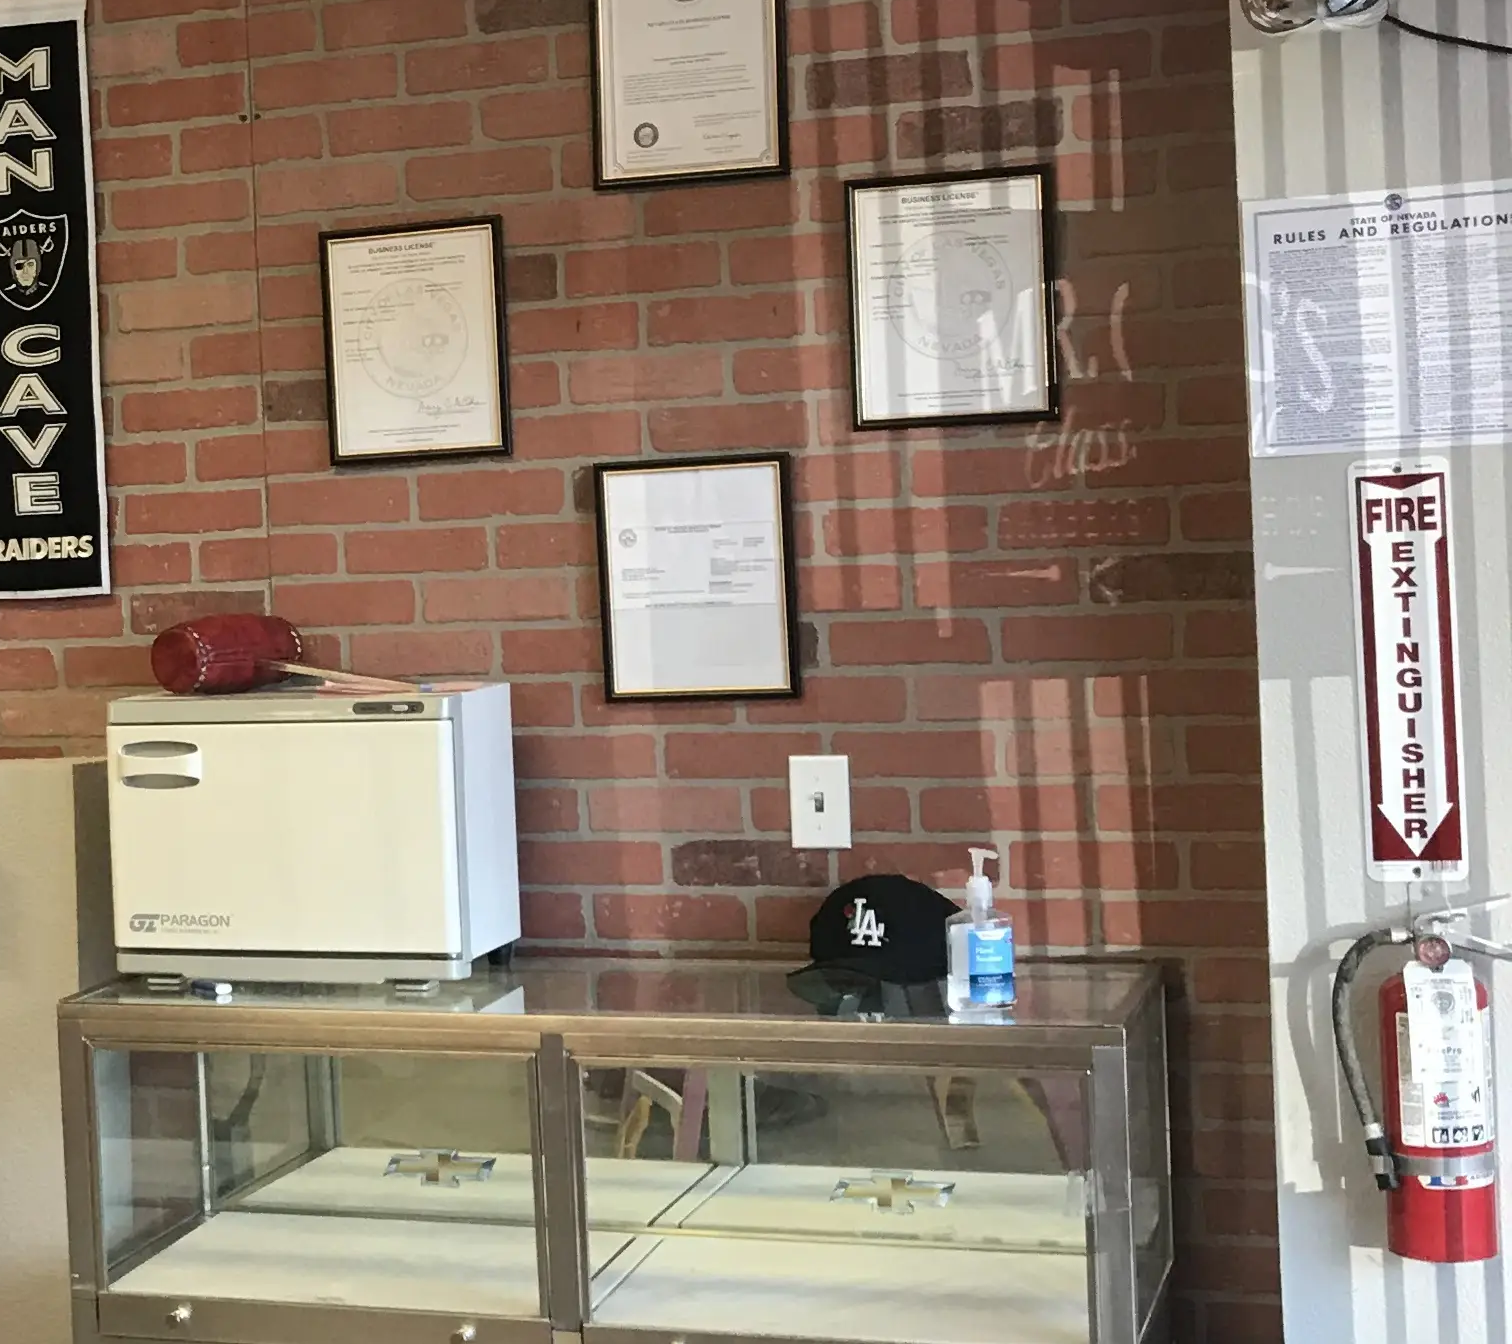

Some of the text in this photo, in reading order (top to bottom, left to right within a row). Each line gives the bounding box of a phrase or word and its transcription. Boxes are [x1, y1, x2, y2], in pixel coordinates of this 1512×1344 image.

[1273, 213, 1512, 245] RULES AND REGULATION
[1350, 216, 1377, 226] STATE
[1396, 211, 1437, 222] NEVADA
[1365, 496, 1438, 533] FIRE
[1391, 541, 1428, 839] EXTINGUISHER
[160, 914, 231, 928] PARAGON
[850, 898, 885, 947] LA
